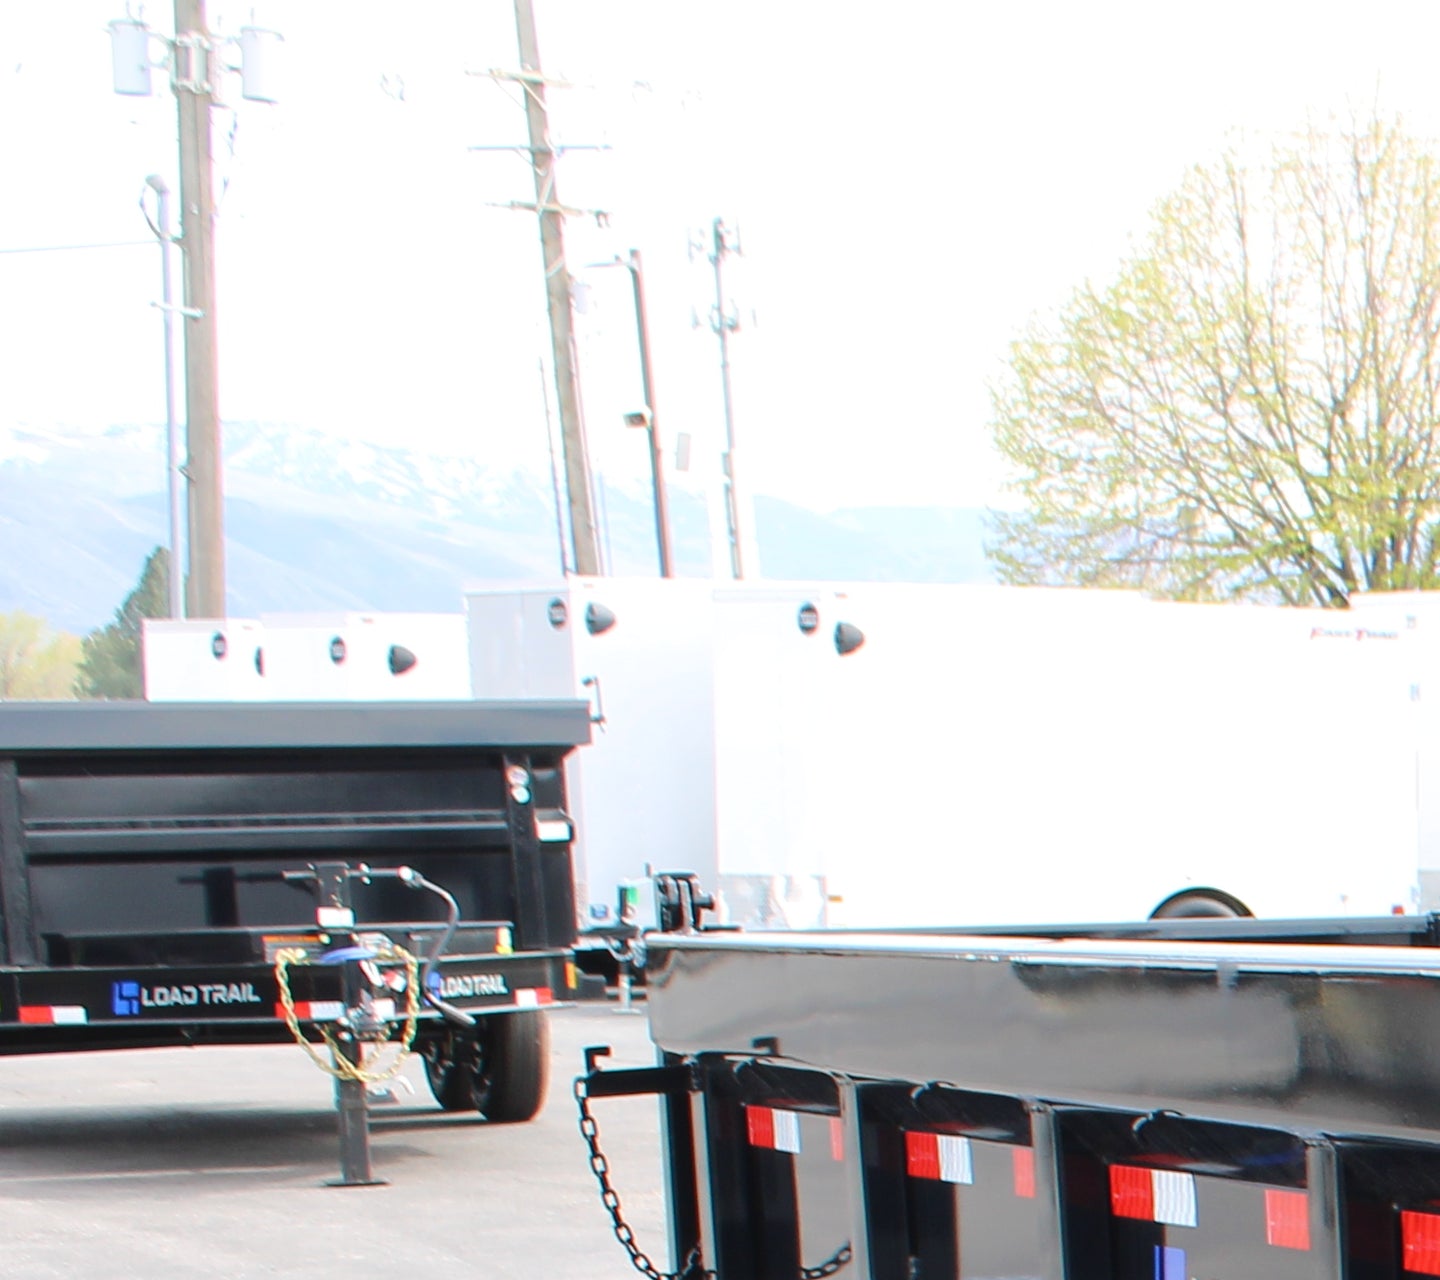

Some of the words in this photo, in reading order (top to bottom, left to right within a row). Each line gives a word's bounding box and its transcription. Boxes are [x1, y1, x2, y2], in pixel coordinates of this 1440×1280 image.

[141, 983, 198, 1009] LOAD
[198, 982, 261, 1005] TRAIL
[475, 972, 509, 995] TRAIL
